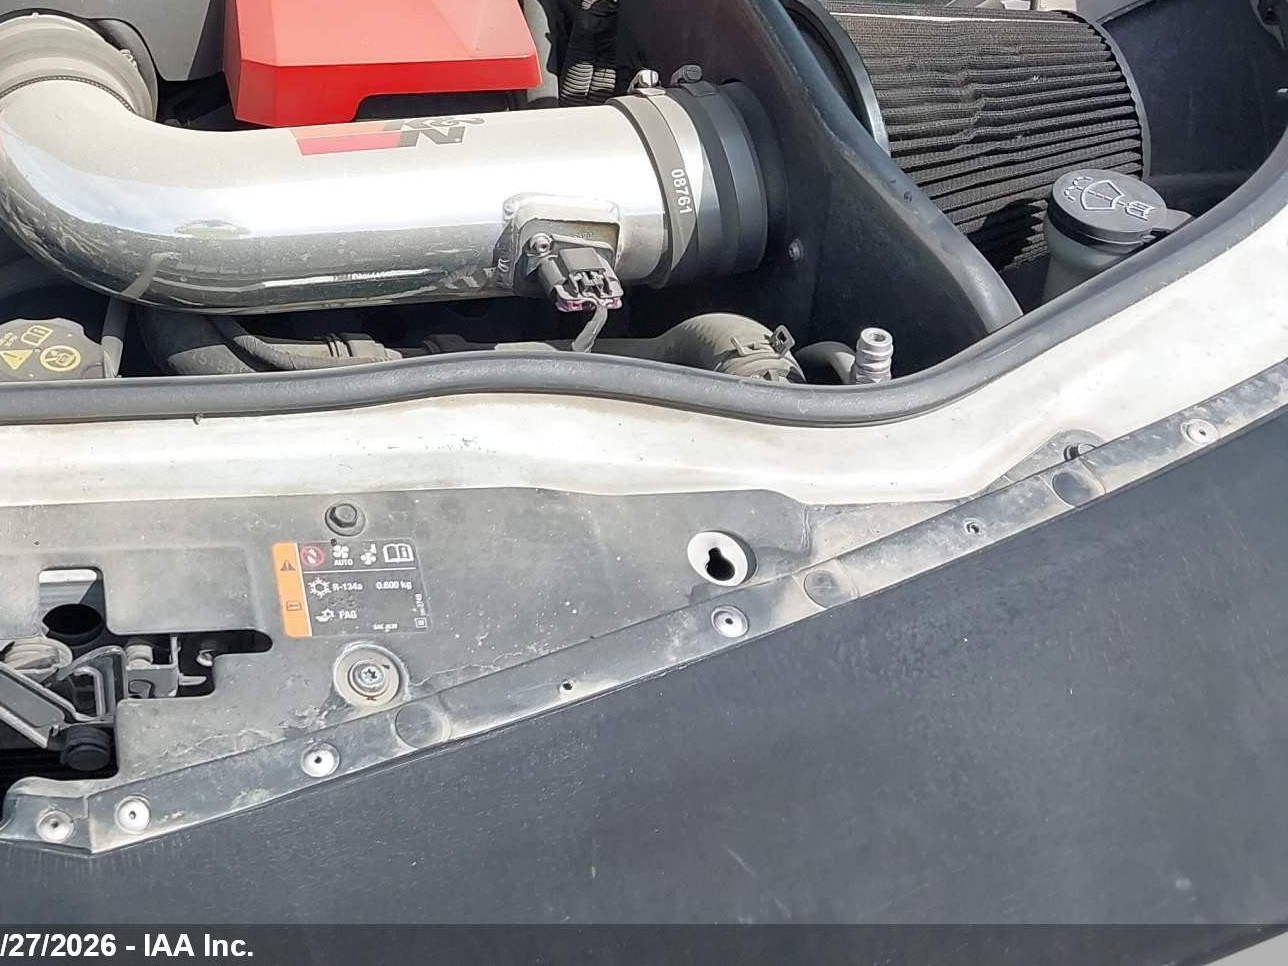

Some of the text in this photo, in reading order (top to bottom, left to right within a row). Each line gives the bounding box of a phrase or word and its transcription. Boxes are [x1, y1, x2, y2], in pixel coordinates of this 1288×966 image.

[671, 168, 694, 214] 08761
[332, 582, 364, 591] R-134a
[400, 581, 412, 590] kg
[338, 610, 358, 619] PAG
